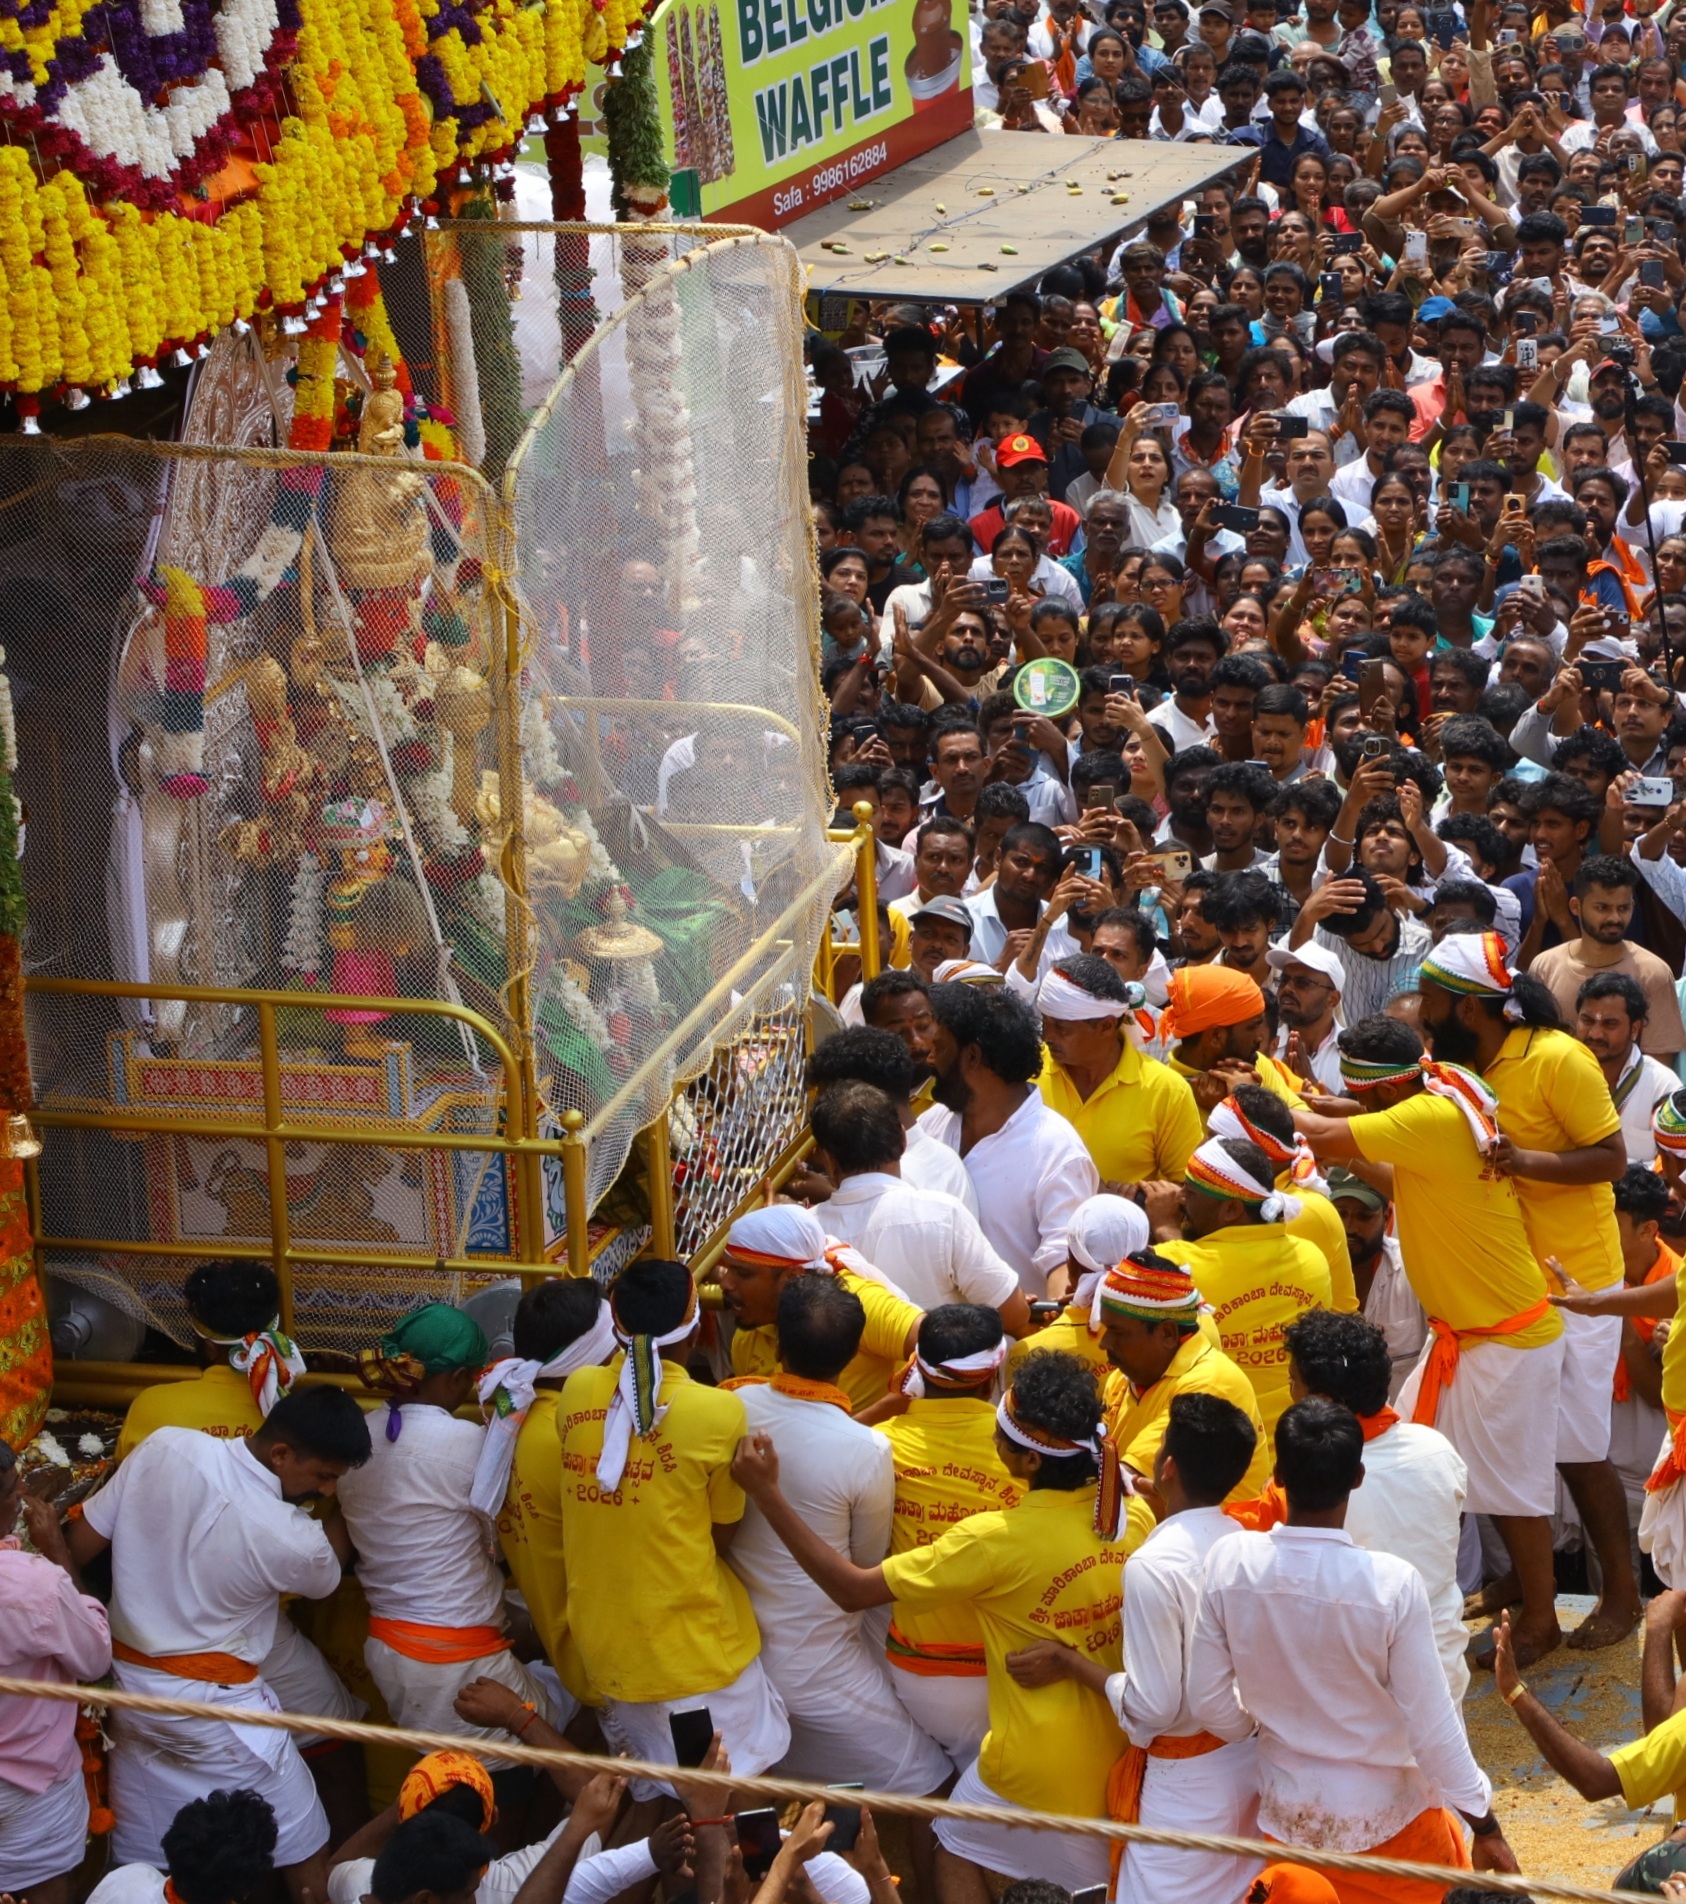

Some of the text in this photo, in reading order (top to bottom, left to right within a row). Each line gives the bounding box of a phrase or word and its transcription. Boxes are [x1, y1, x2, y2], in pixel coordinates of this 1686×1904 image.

[737, 0, 893, 65] BELG
[754, 35, 891, 166] WAFFLE
[773, 186, 803, 215] Safa
[812, 141, 887, 196] 9986162884
